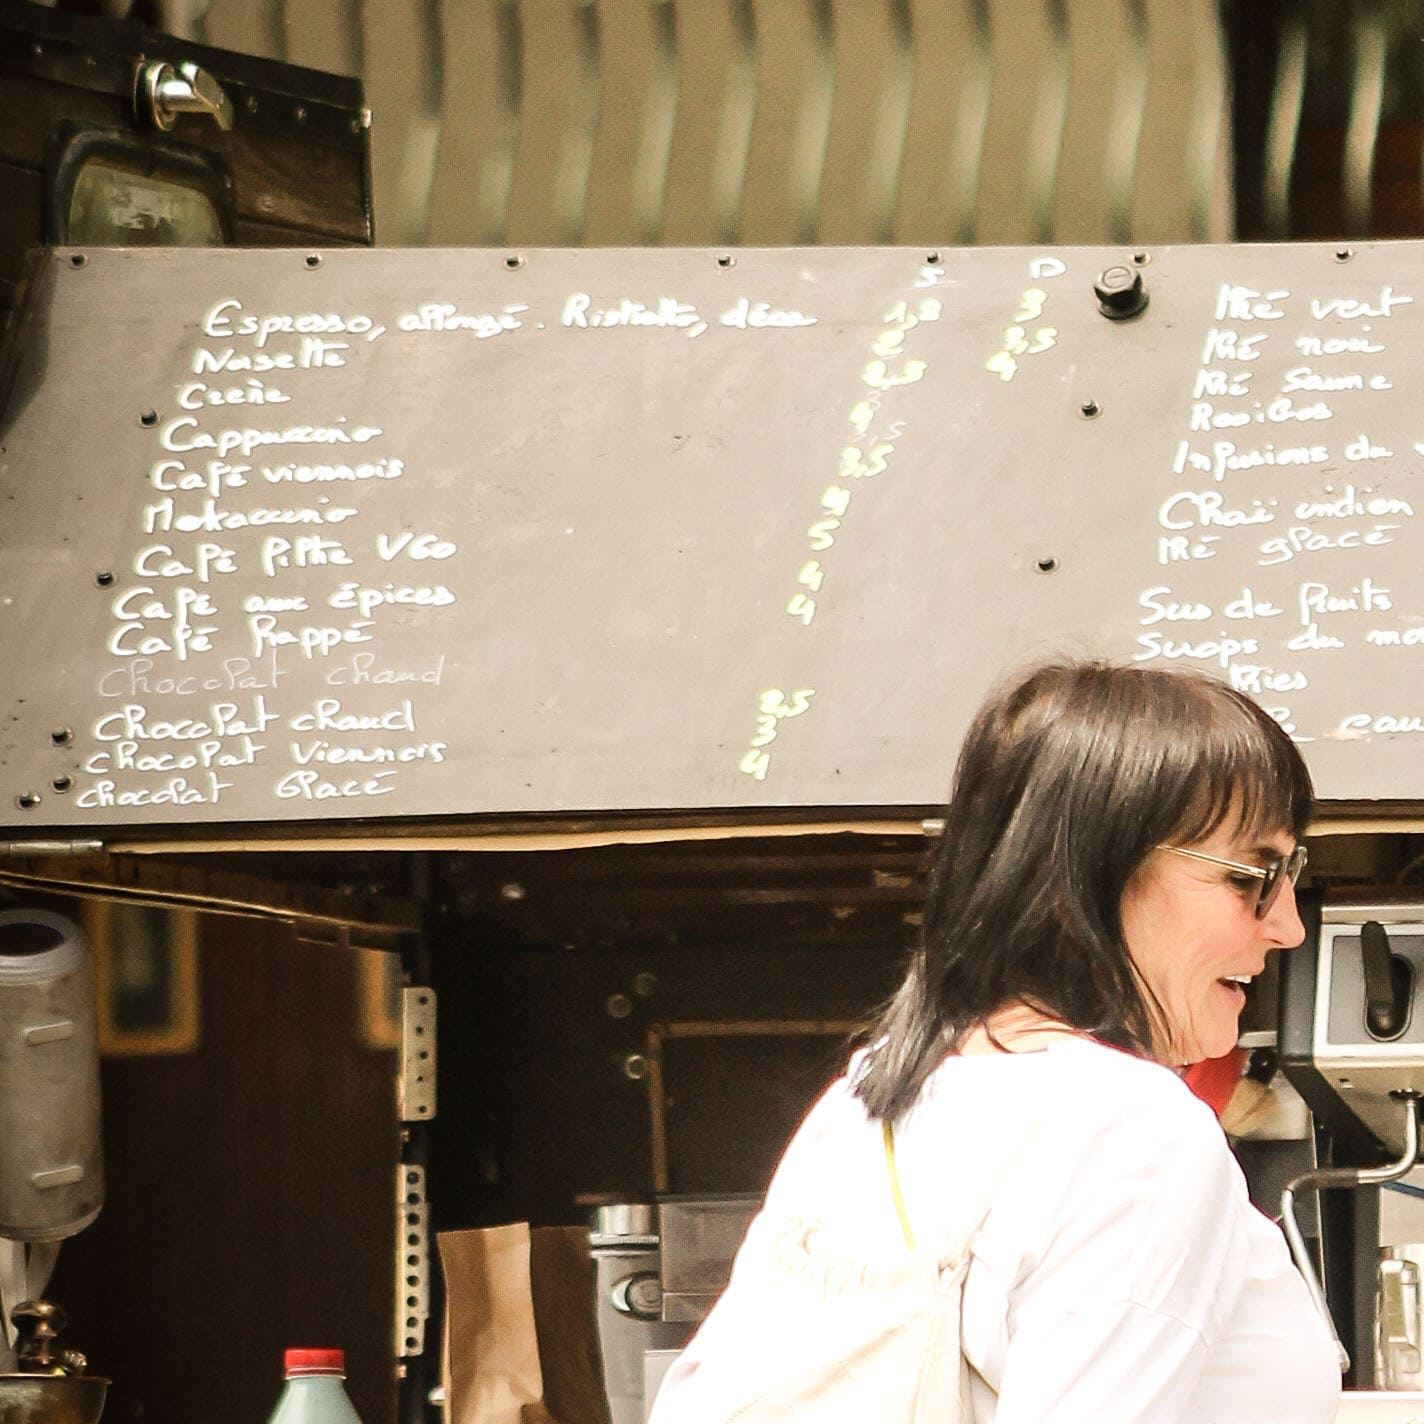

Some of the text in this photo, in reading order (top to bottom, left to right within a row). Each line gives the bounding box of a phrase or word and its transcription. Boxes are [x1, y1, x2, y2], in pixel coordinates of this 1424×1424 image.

[204, 300, 386, 348] Espresso,
[151, 461, 252, 498] Café
[785, 592, 816, 626] 4
[738, 748, 771, 781] 4
